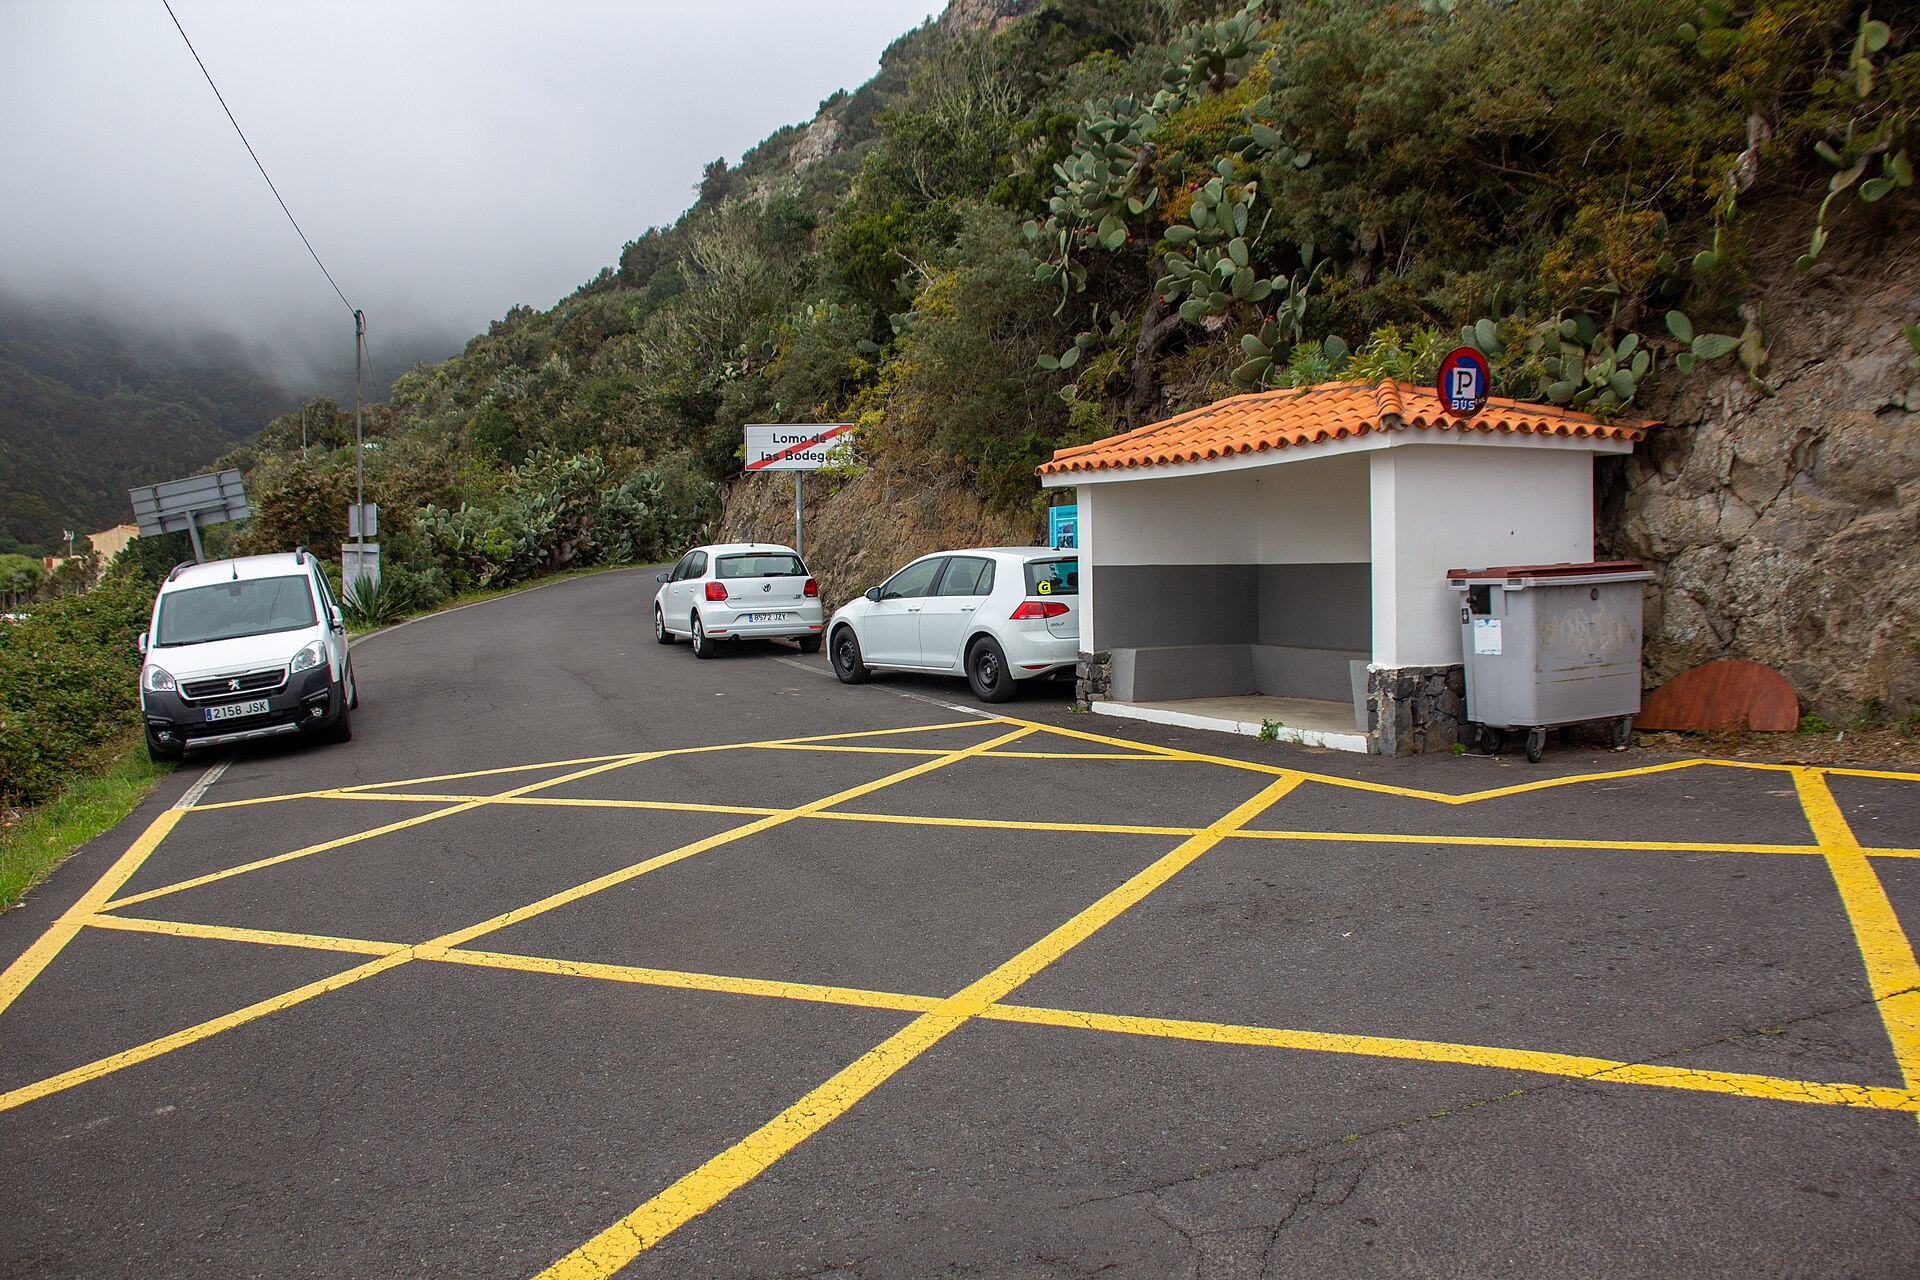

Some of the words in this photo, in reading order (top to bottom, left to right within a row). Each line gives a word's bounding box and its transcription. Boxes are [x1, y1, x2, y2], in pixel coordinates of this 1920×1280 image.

[1456, 370, 1472, 395] P
[1451, 399, 1476, 411] BUS
[772, 432, 808, 444] Lomo
[811, 432, 827, 444] de
[761, 451, 780, 462] las
[213, 705, 242, 718] 2158
[246, 700, 267, 714] JSK
